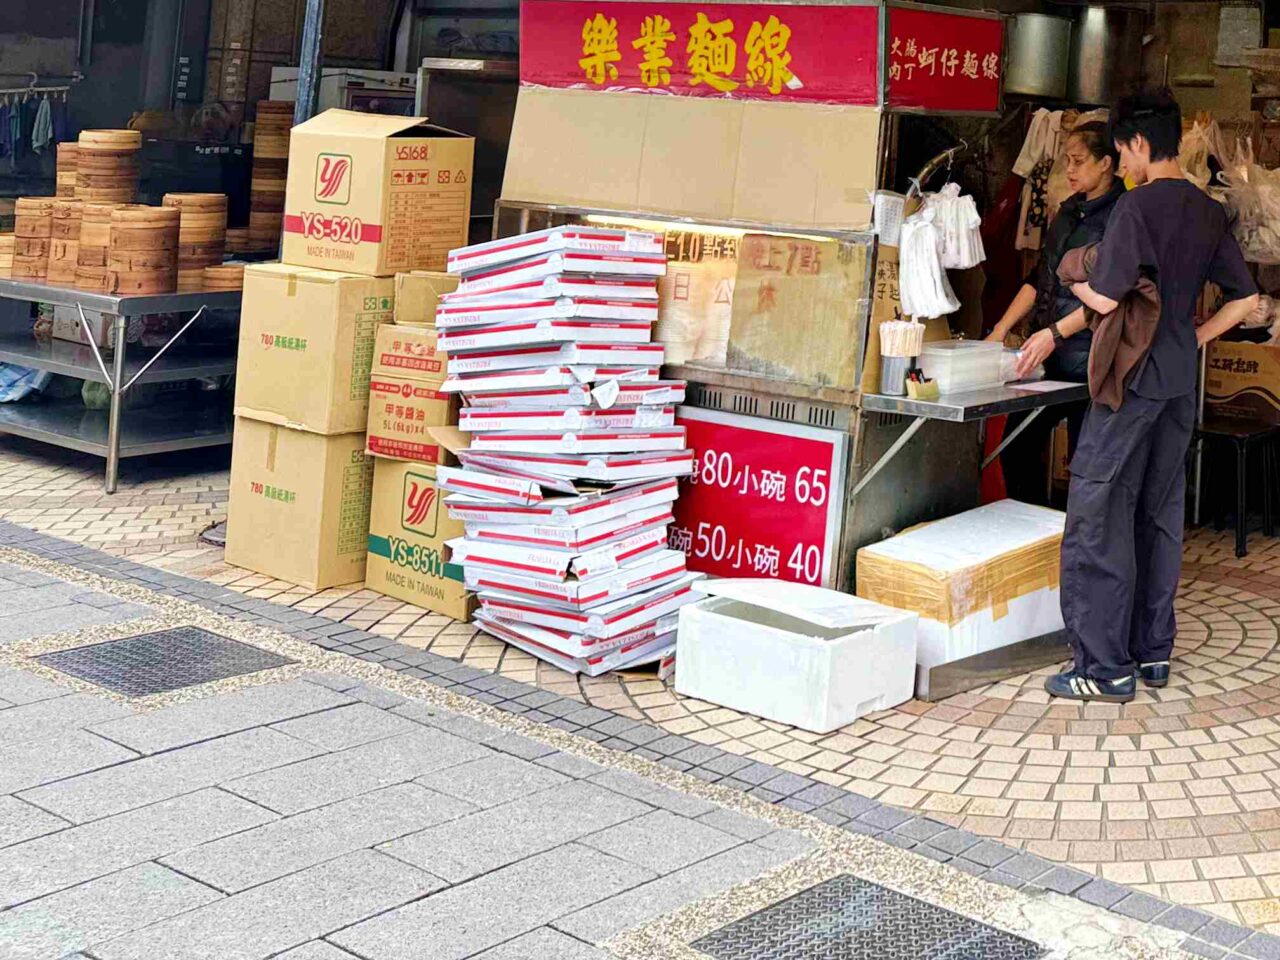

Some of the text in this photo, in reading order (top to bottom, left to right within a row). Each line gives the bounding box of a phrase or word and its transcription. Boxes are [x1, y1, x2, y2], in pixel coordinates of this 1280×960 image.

[578, 12, 803, 94] 樂業麵線
[918, 46, 999, 79] 蚵仔麵線
[301, 211, 362, 244] YS-520
[392, 340, 435, 357] 甲等油
[250, 481, 264, 495] 780
[794, 465, 827, 507] 65
[787, 542, 821, 583] 40
[386, 571, 445, 601] MADE IN TAIWAN
